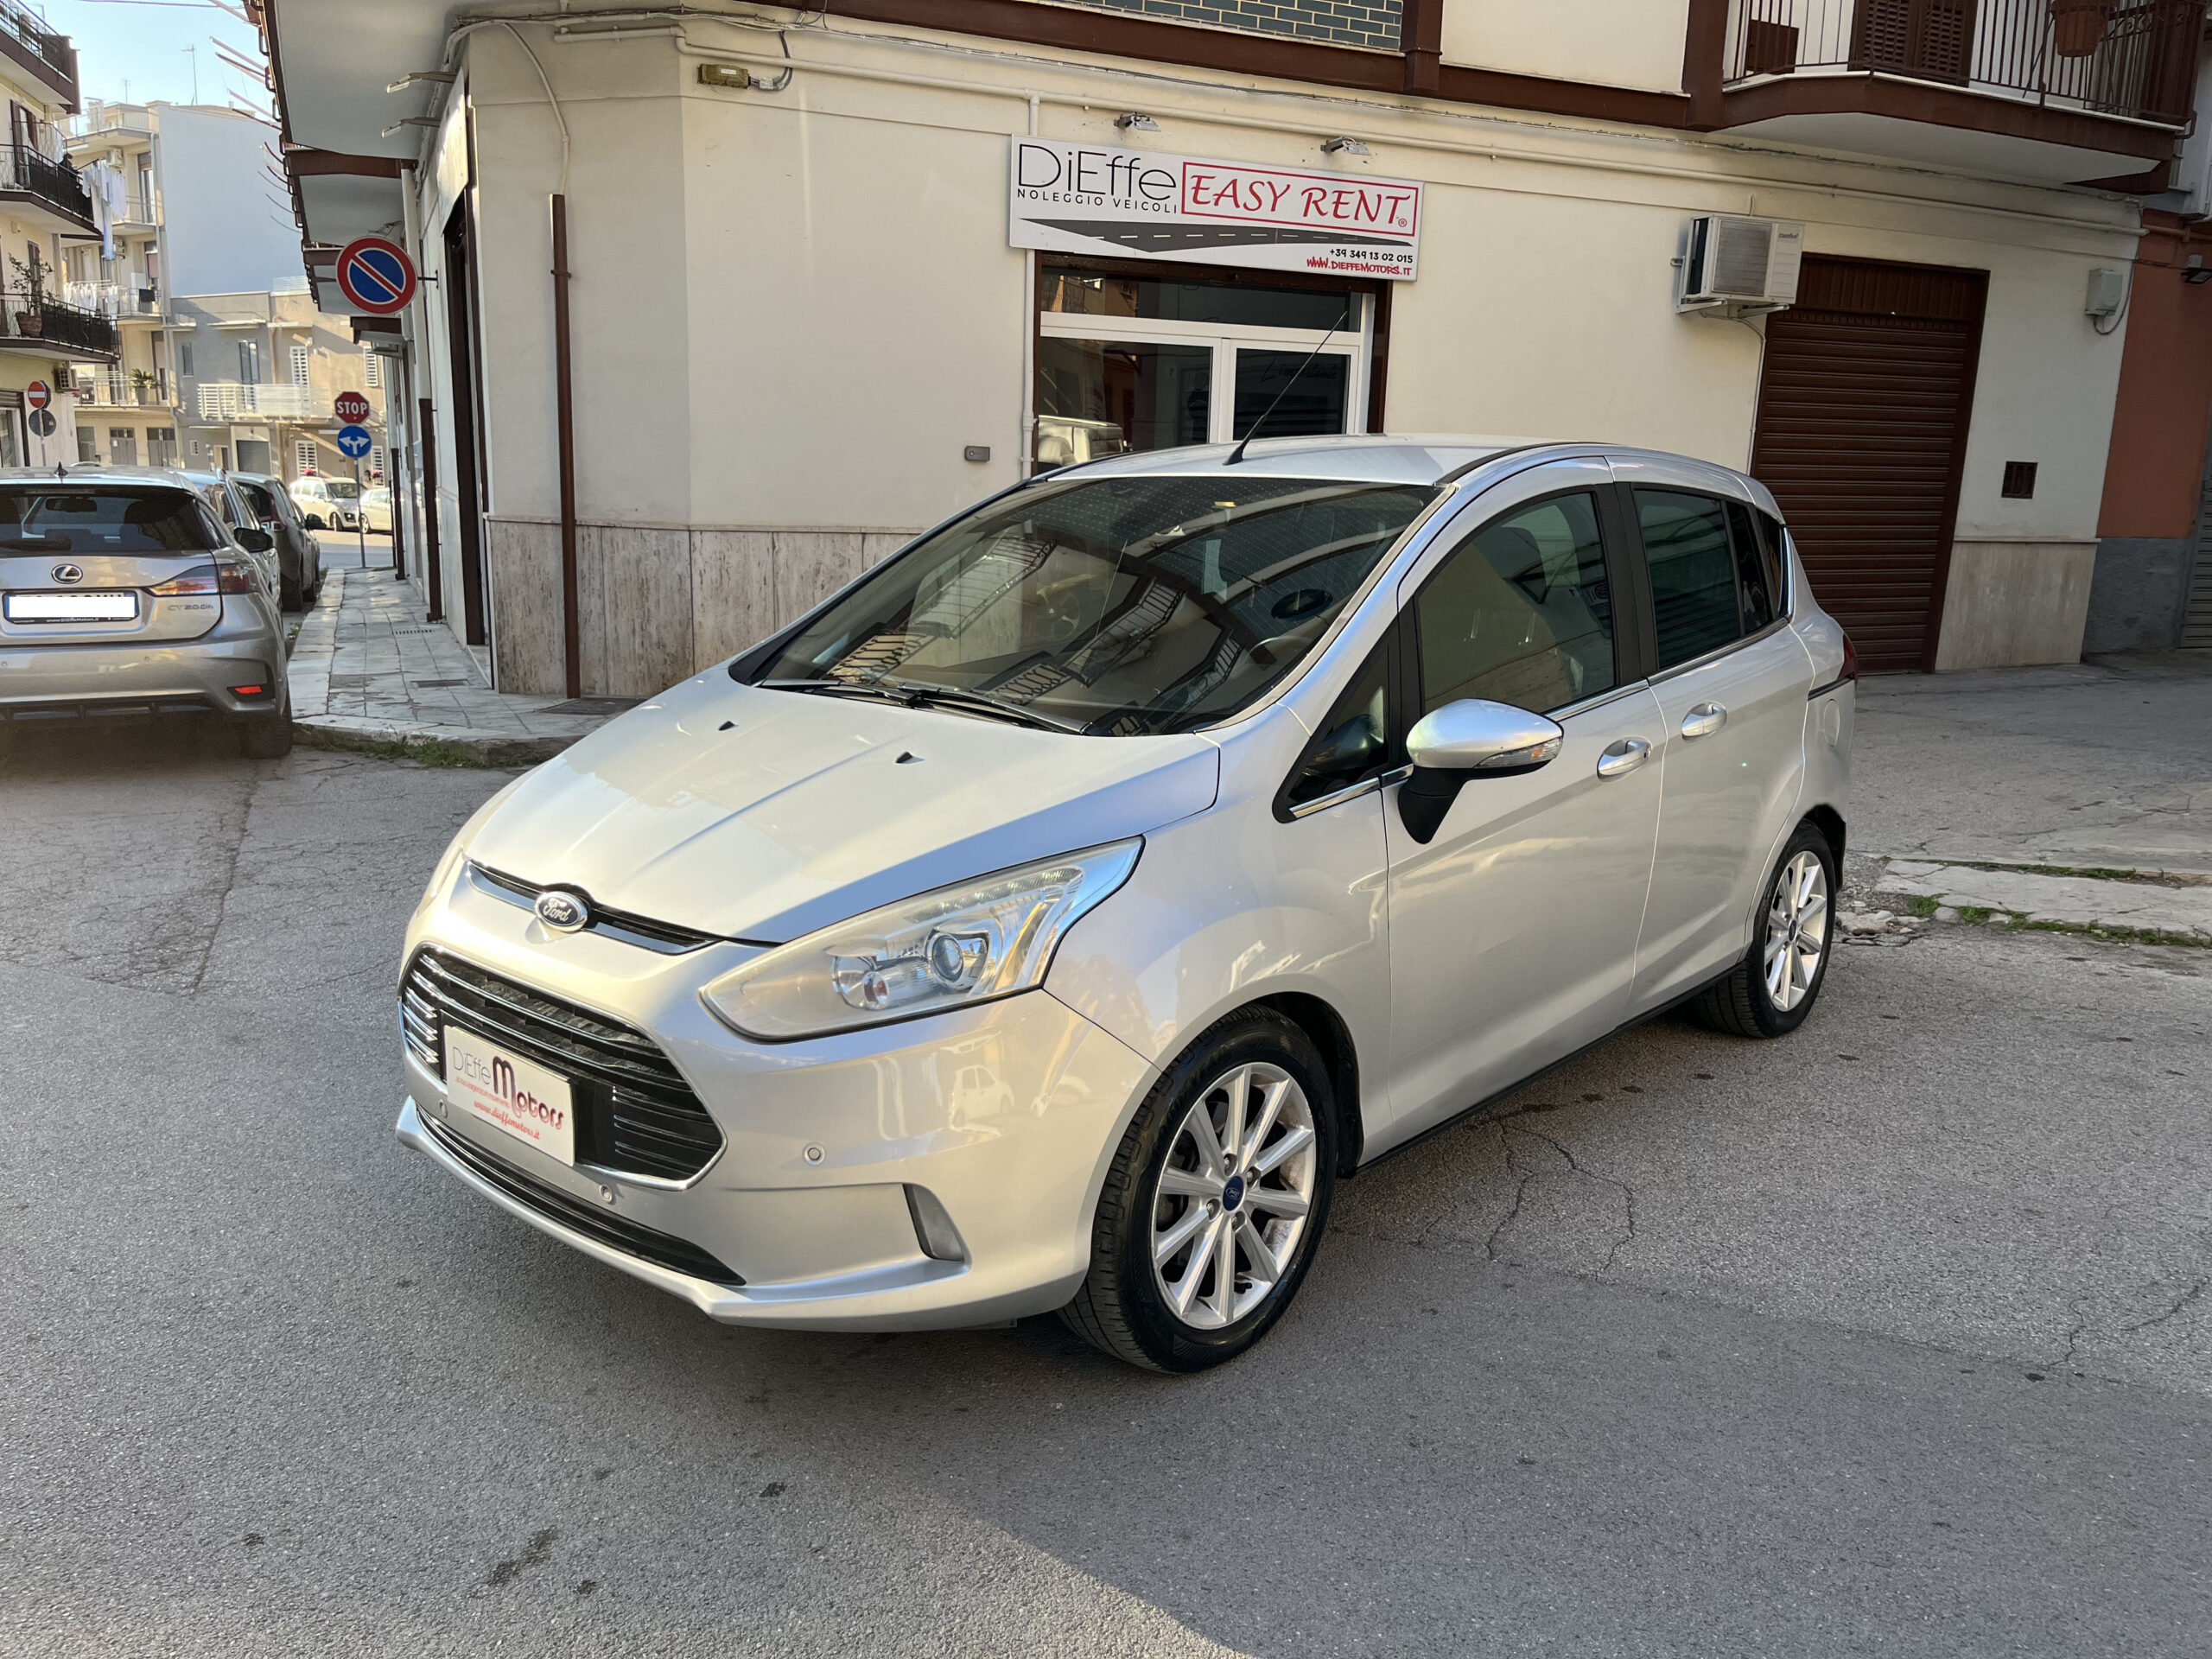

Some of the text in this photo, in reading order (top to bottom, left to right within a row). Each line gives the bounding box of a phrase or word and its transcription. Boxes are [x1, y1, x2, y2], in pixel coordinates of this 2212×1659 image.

[1019, 143, 1176, 200] DiEffe
[1017, 188, 1177, 213] NOLEGGIO VEICOLI
[1191, 175, 1410, 225] EASY RENT
[1330, 248, 1414, 264] +39 349 13 02 015
[336, 401, 367, 415] STOP
[543, 897, 573, 922] Ford
[453, 1046, 492, 1085] DiEffe
